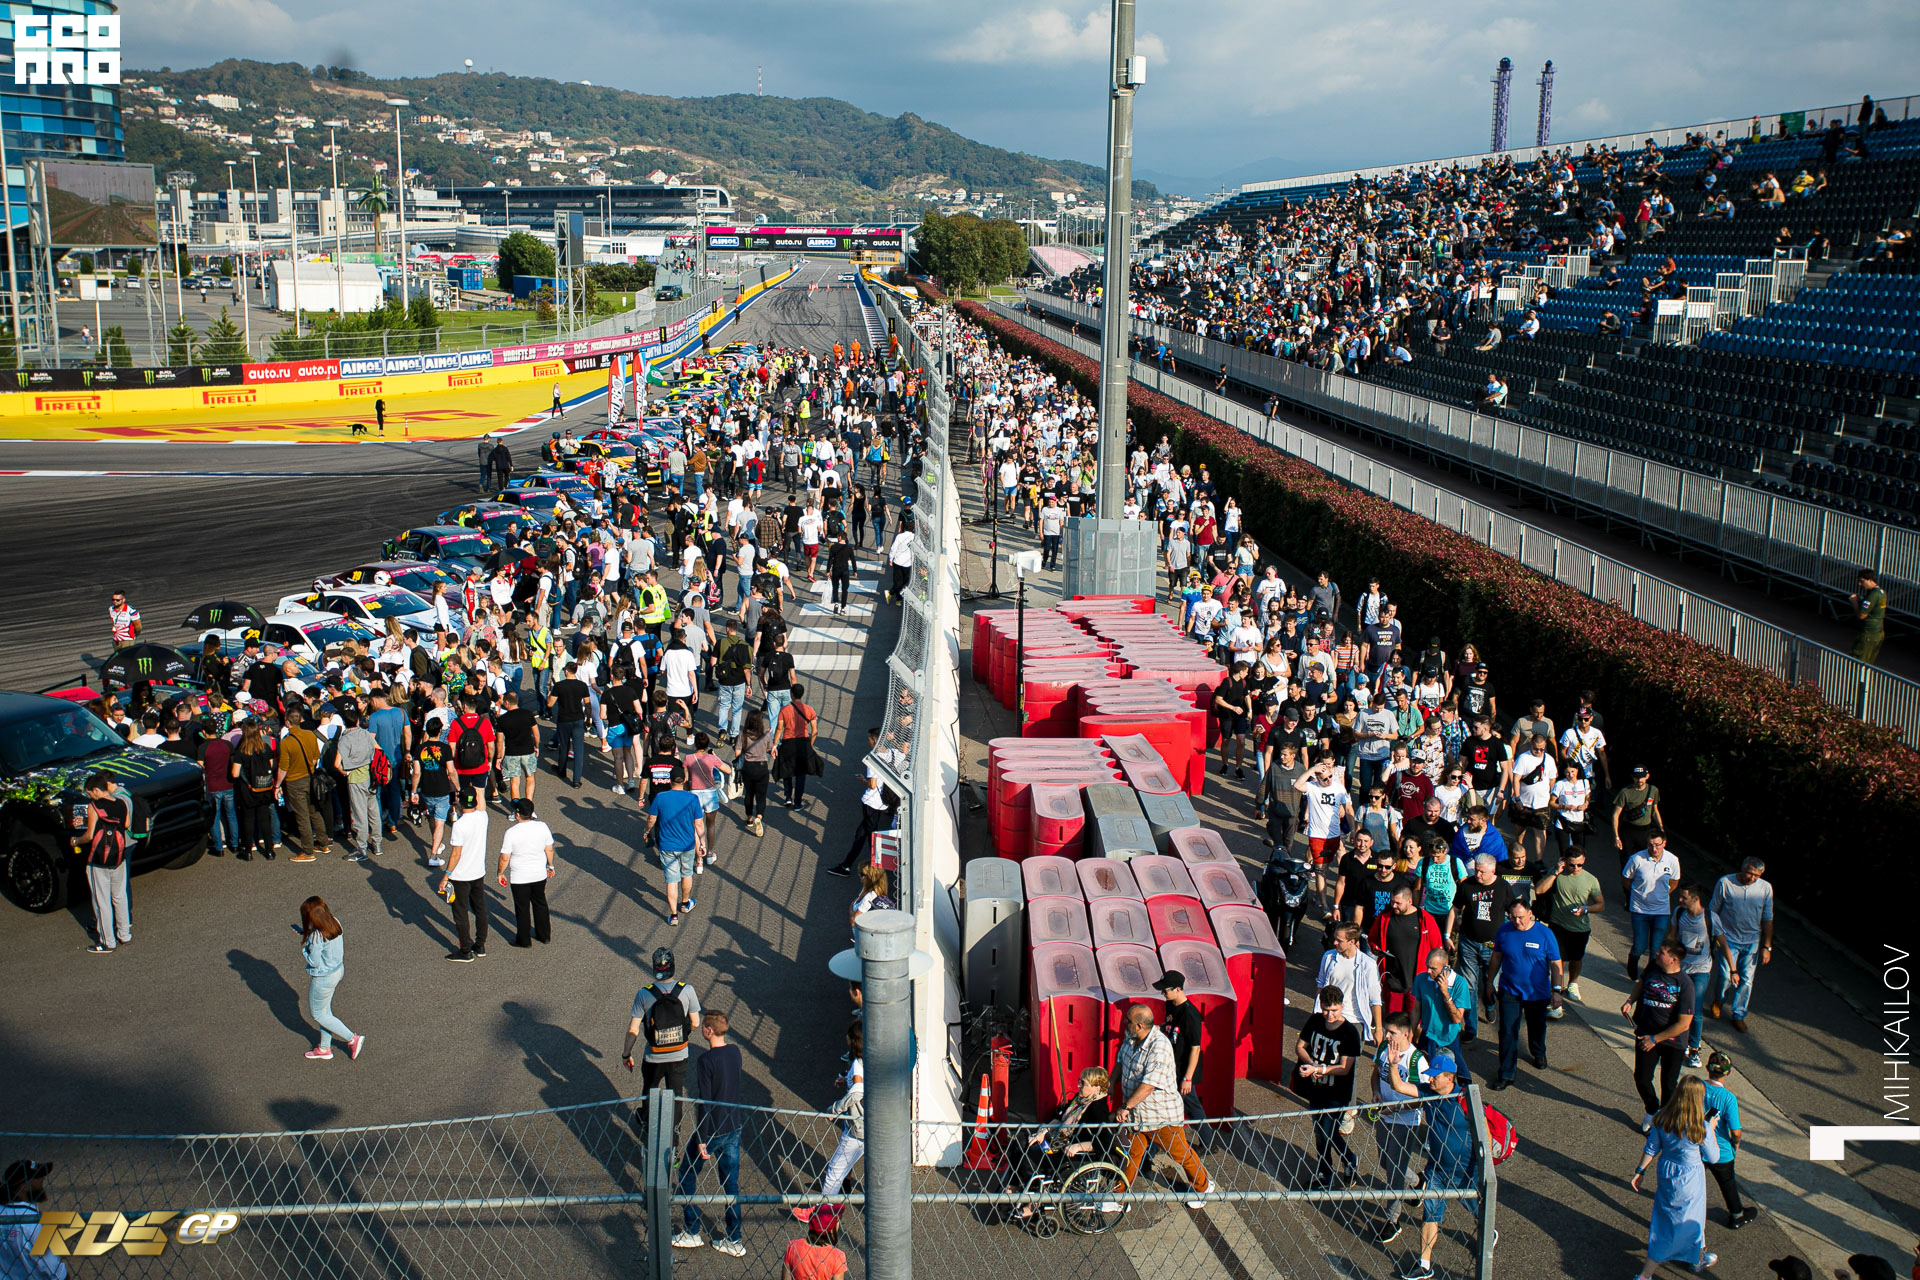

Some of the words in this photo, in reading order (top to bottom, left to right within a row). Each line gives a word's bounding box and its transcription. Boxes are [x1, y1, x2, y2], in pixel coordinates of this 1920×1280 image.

[711, 238, 738, 246] AIMOL
[808, 238, 835, 246] AIMOL
[547, 344, 565, 357] RDS
[386, 358, 421, 371] AIMOL
[425, 355, 459, 368] AIMOL
[461, 352, 491, 365] AIMOL
[248, 368, 291, 379] auto.ru
[298, 364, 338, 377] auto.ru
[342, 361, 382, 374] AIMOL
[533, 363, 559, 377] PIRELLI
[448, 372, 482, 387] PIRELLI
[339, 381, 382, 396] PIRELLI
[35, 396, 101, 411] PIRELLI
[202, 389, 257, 405] PIRELLI
[1321, 793, 1336, 806] DC
